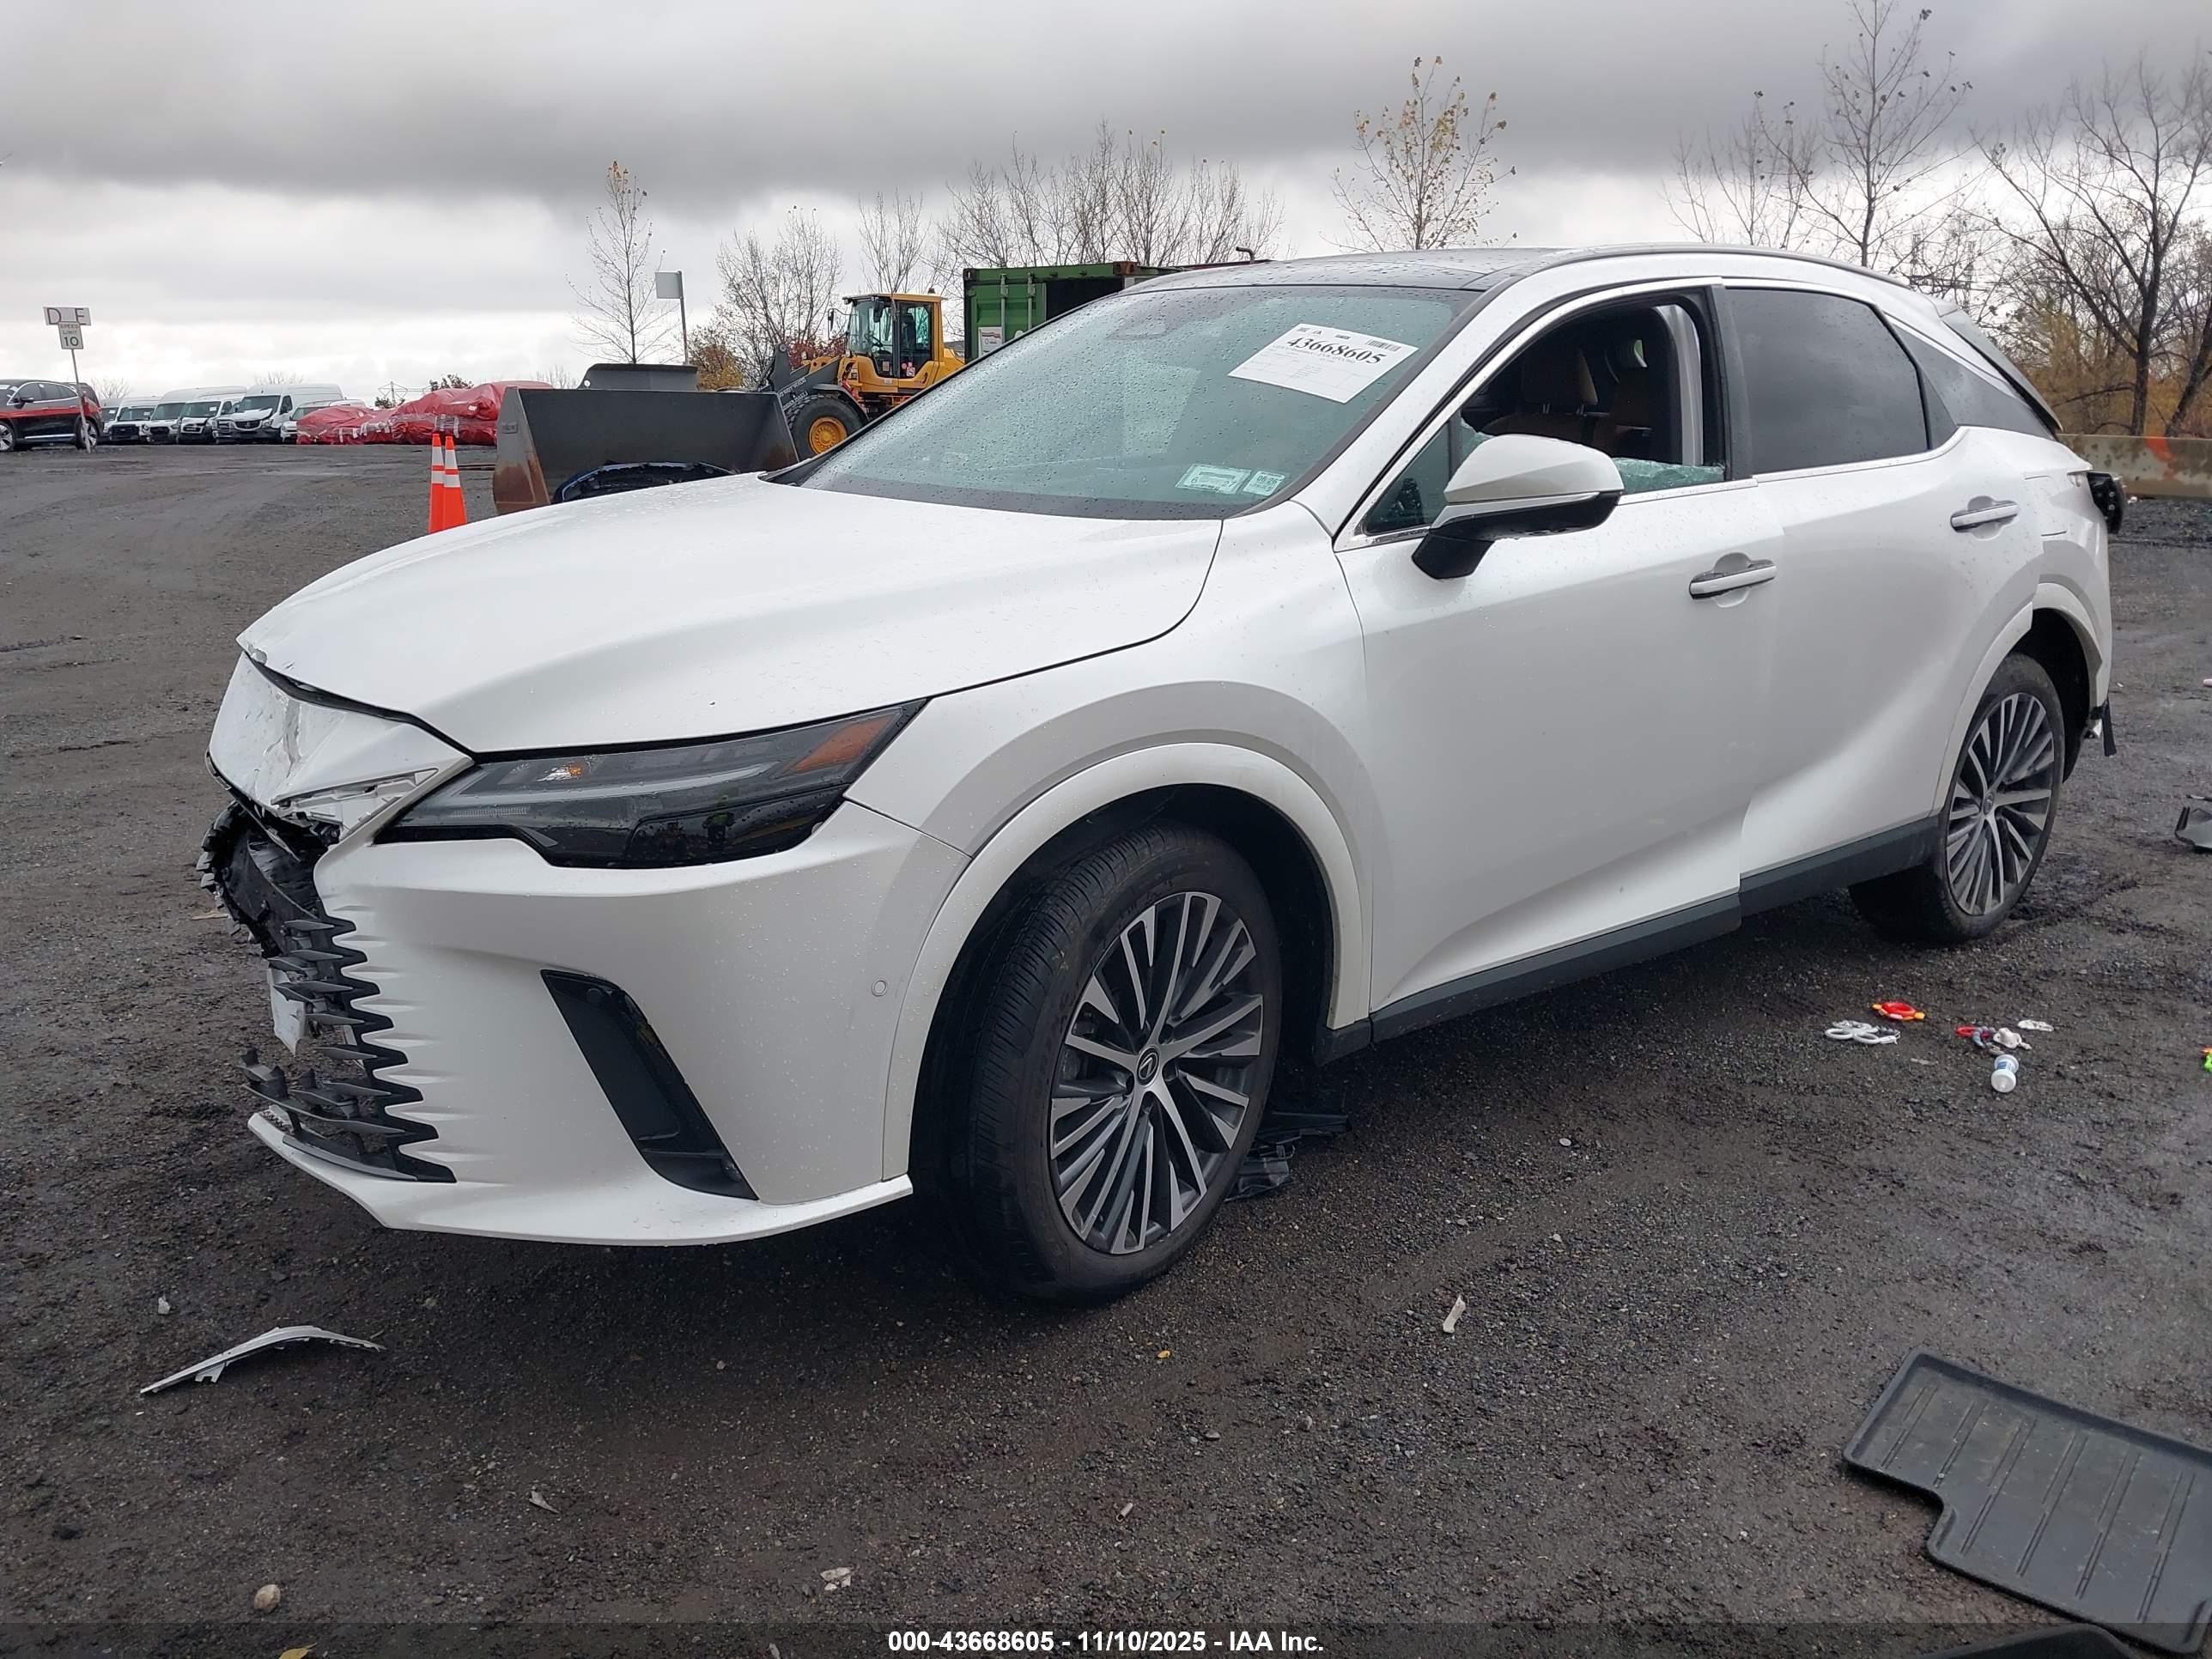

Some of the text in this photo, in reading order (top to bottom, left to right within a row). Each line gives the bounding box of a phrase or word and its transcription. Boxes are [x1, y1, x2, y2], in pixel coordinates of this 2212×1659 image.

[47, 307, 86, 325] D E
[64, 336, 79, 347] 10
[1287, 337, 1388, 364] 43668605
